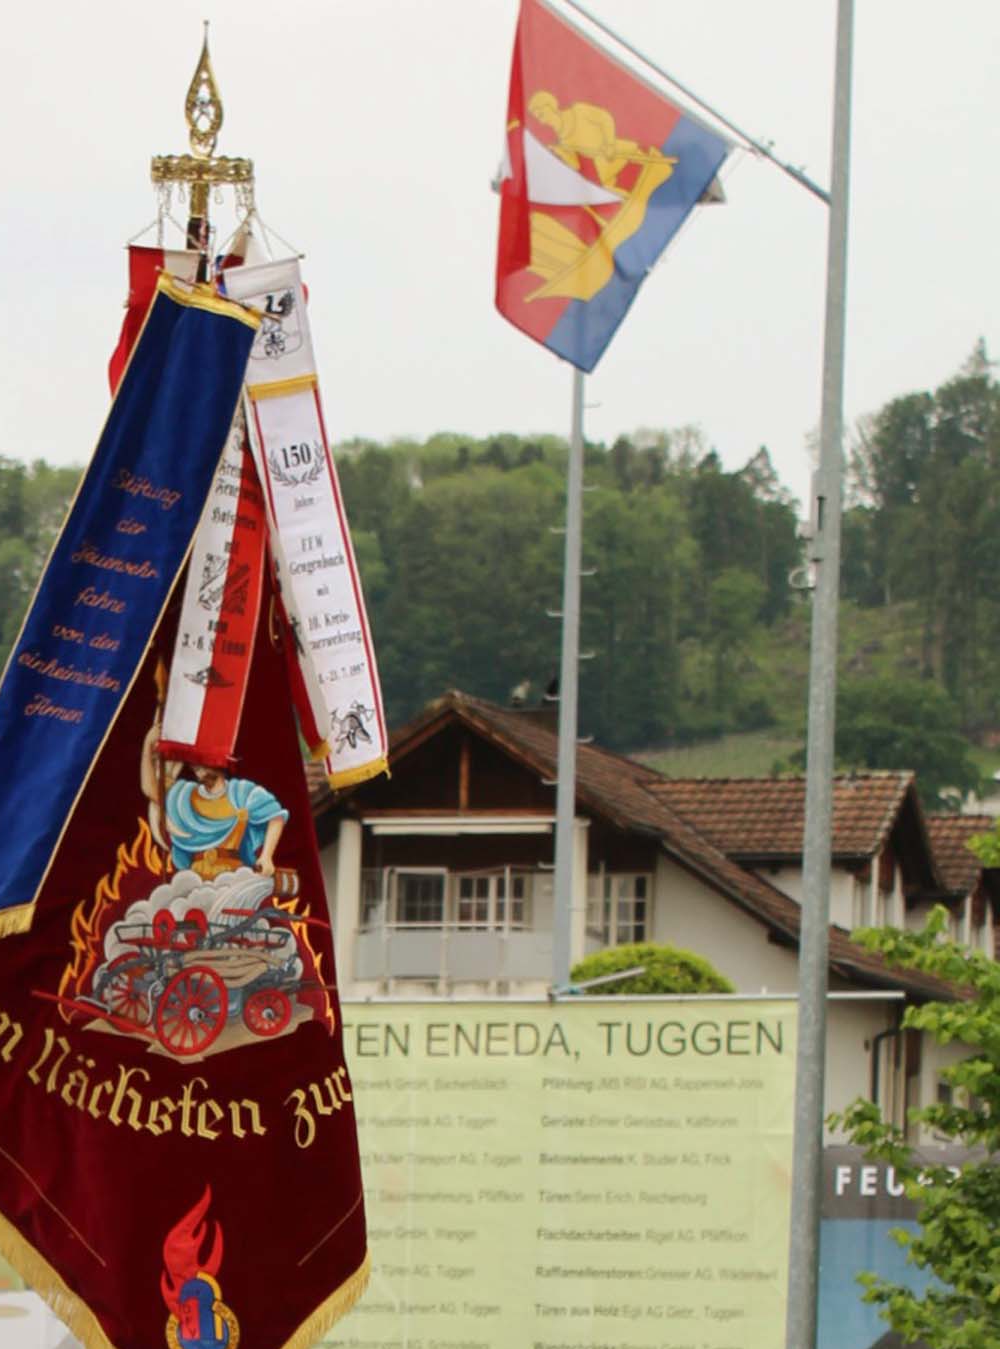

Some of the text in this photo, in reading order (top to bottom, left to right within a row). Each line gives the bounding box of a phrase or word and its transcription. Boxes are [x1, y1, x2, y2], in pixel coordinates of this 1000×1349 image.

[281, 443, 312, 468] 150
[117, 519, 147, 535] der
[426, 1022, 580, 1062] ENEDA,
[597, 1021, 784, 1057] TUGGEN
[28, 1028, 267, 1142] Nächsten
